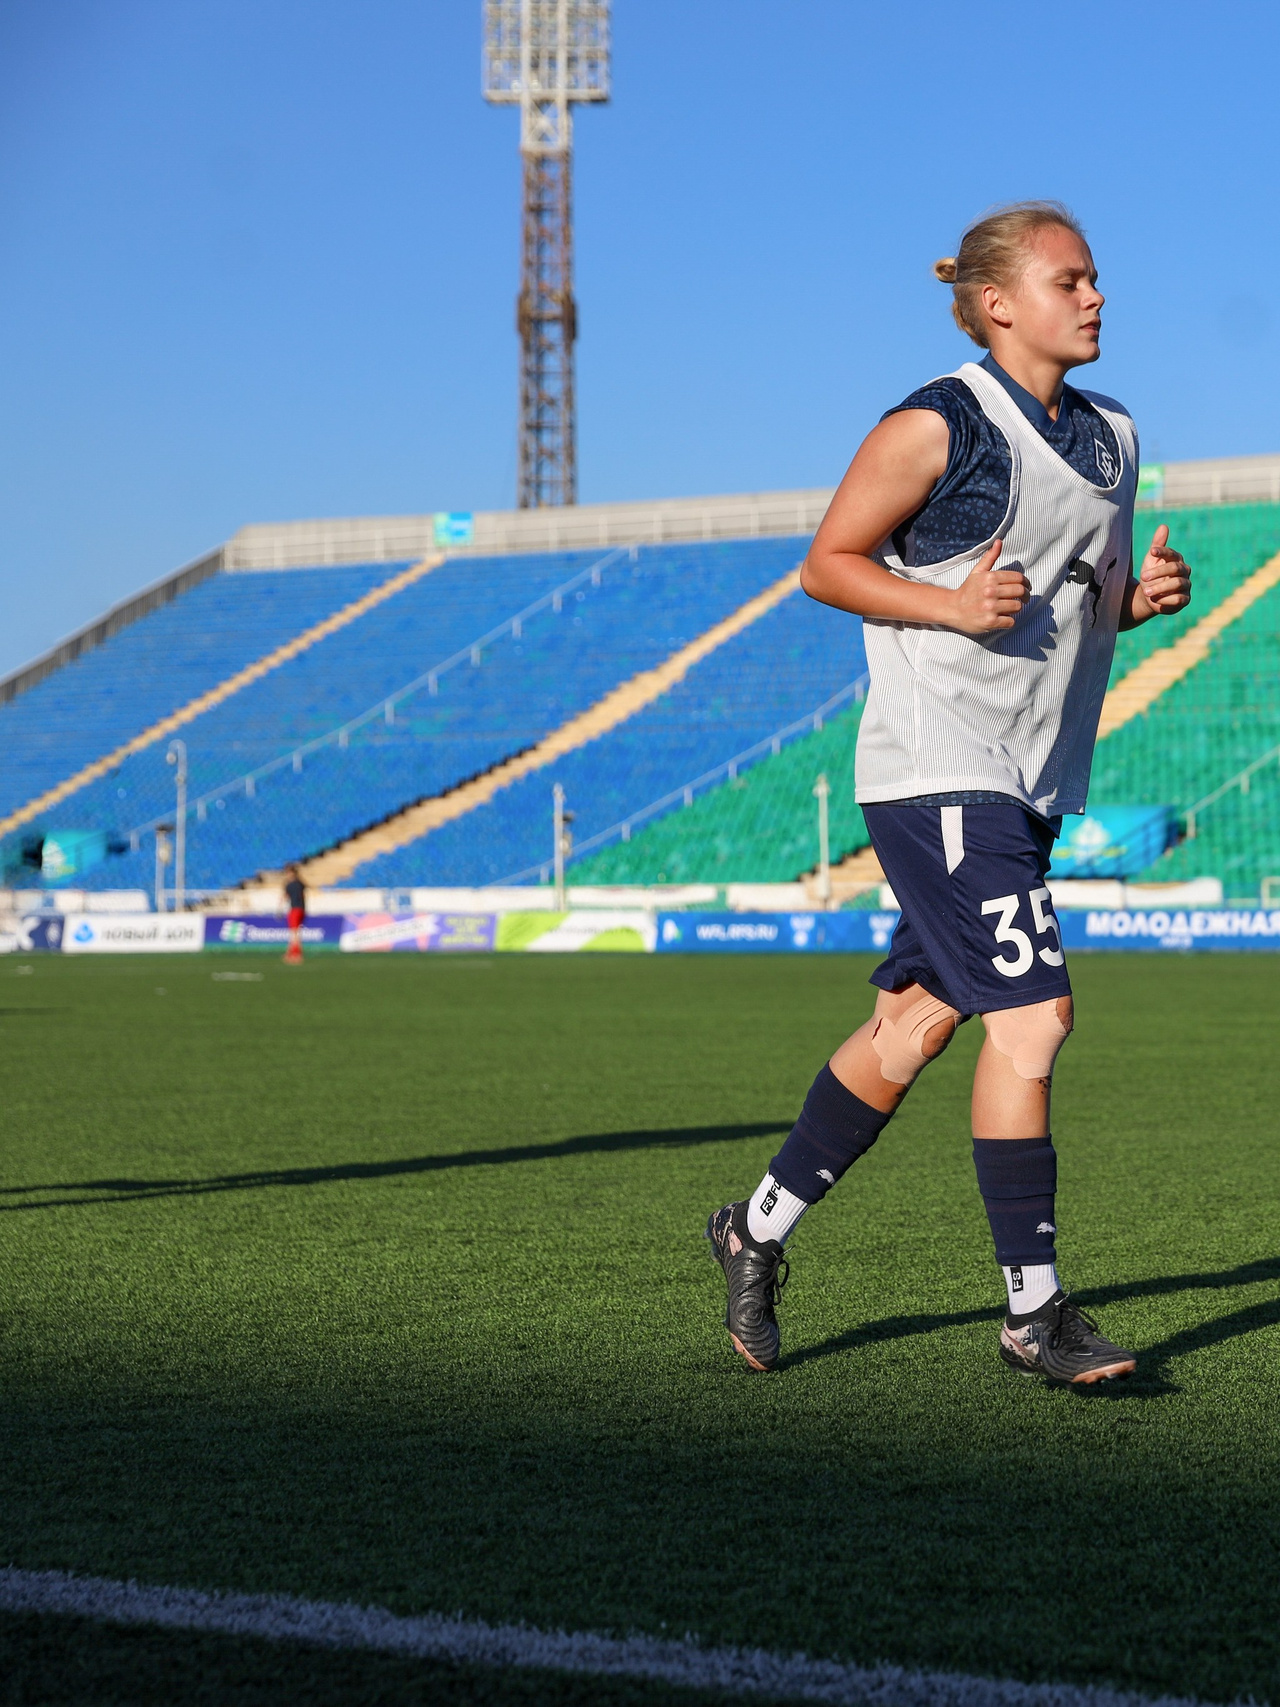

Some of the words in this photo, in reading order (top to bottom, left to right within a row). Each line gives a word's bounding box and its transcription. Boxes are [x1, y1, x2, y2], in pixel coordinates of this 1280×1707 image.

[981, 887, 1065, 977] 35
[761, 1196, 775, 1214] FS
[1012, 1272, 1022, 1290] FS
